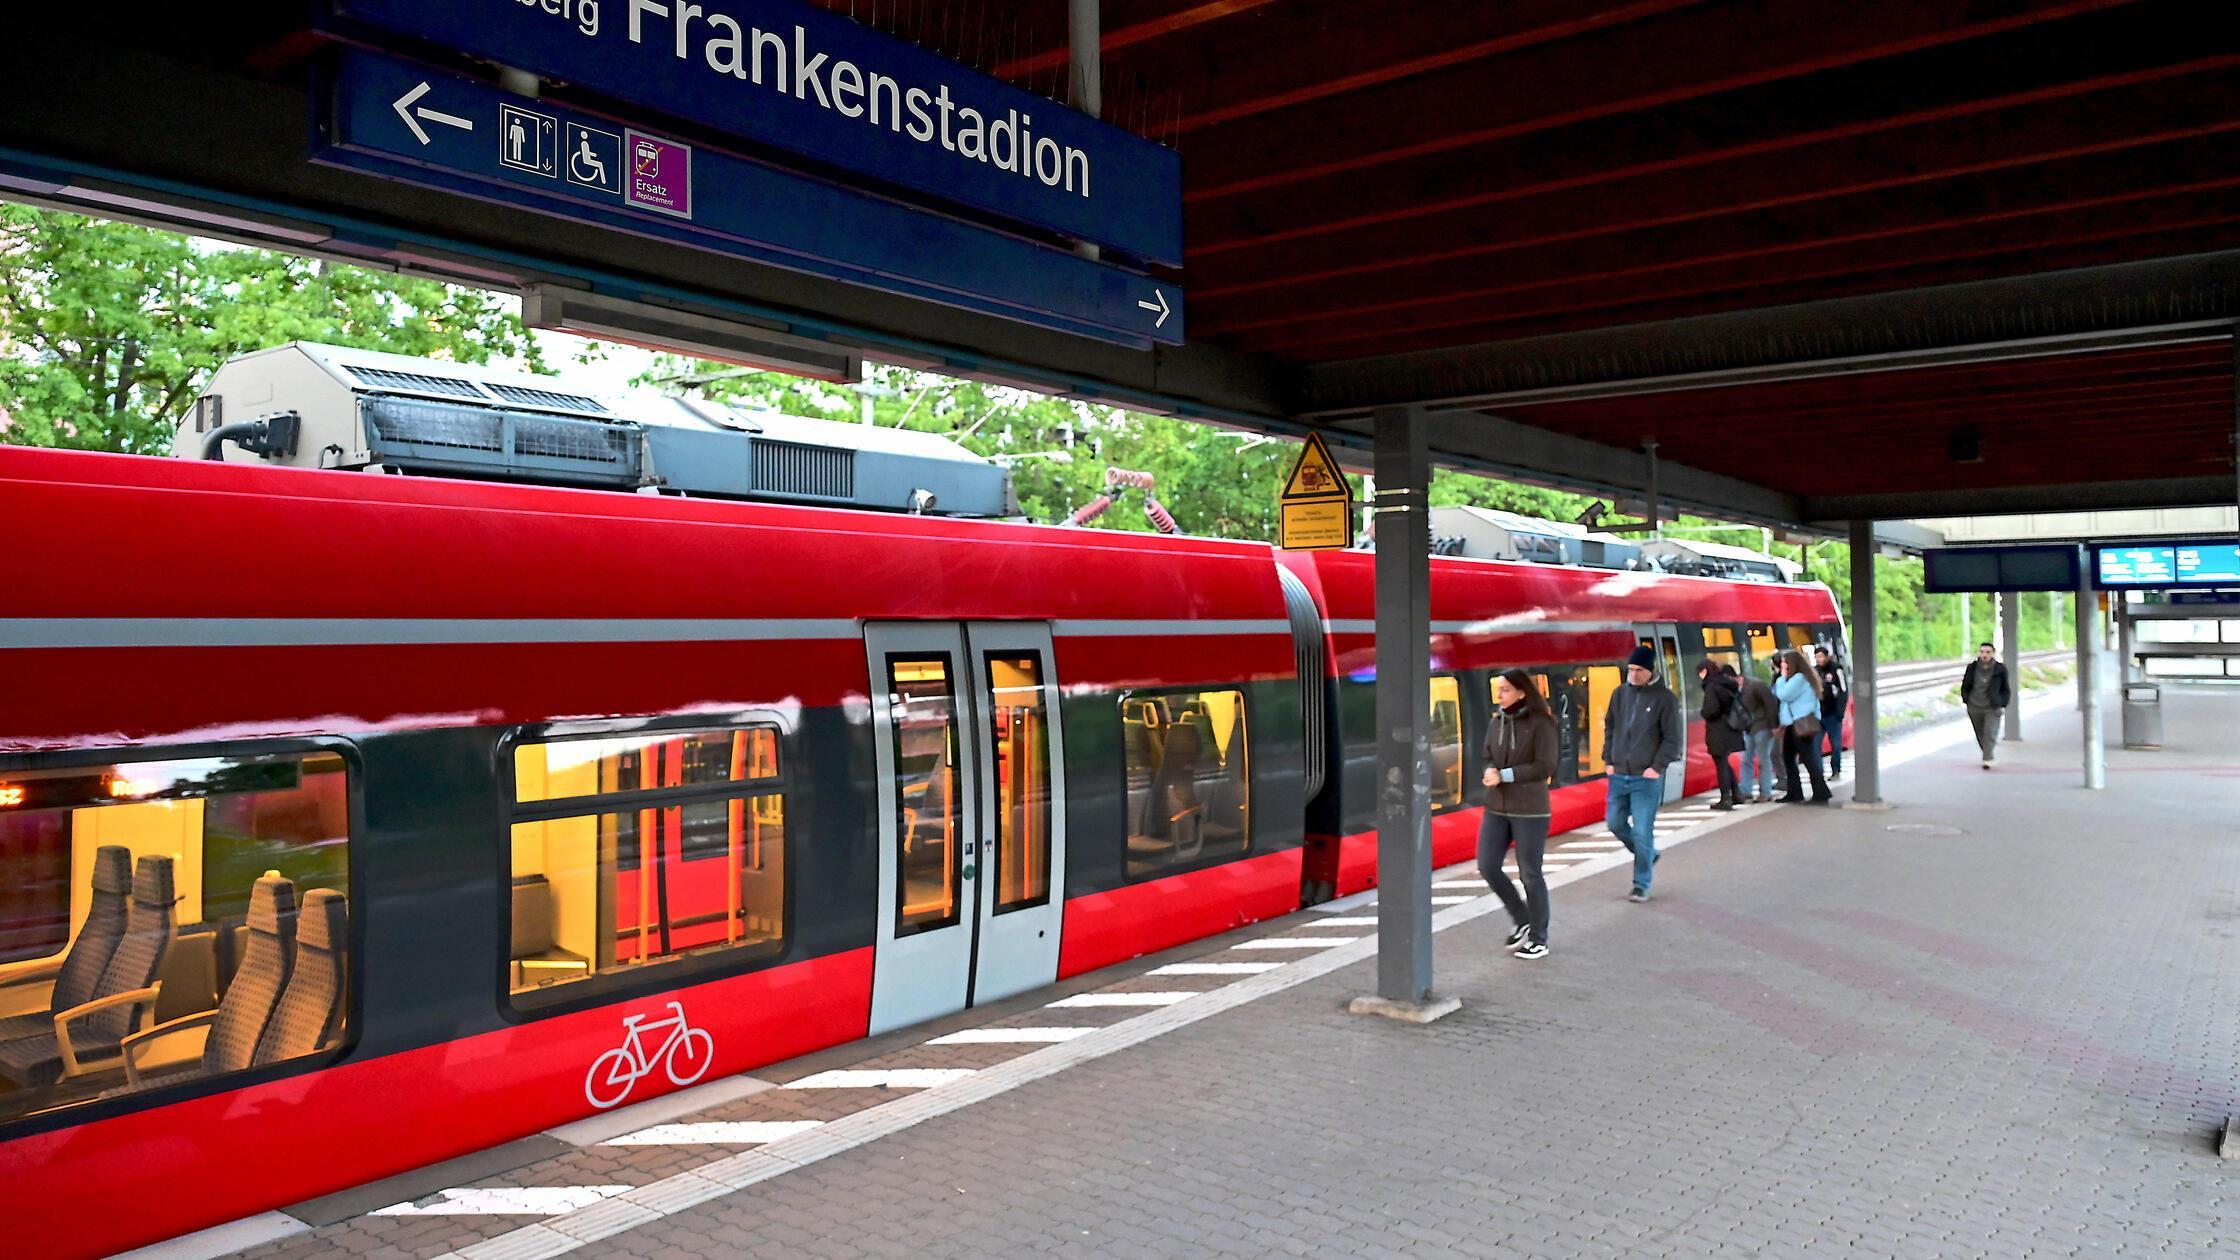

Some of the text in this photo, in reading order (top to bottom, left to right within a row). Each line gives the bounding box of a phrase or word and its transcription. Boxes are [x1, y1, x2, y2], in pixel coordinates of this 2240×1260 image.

[628, 0, 1089, 198] Frankenstadion
[636, 179, 667, 196] Ersatz
[635, 191, 674, 206] Replacement
[1560, 694, 1569, 718] 2
